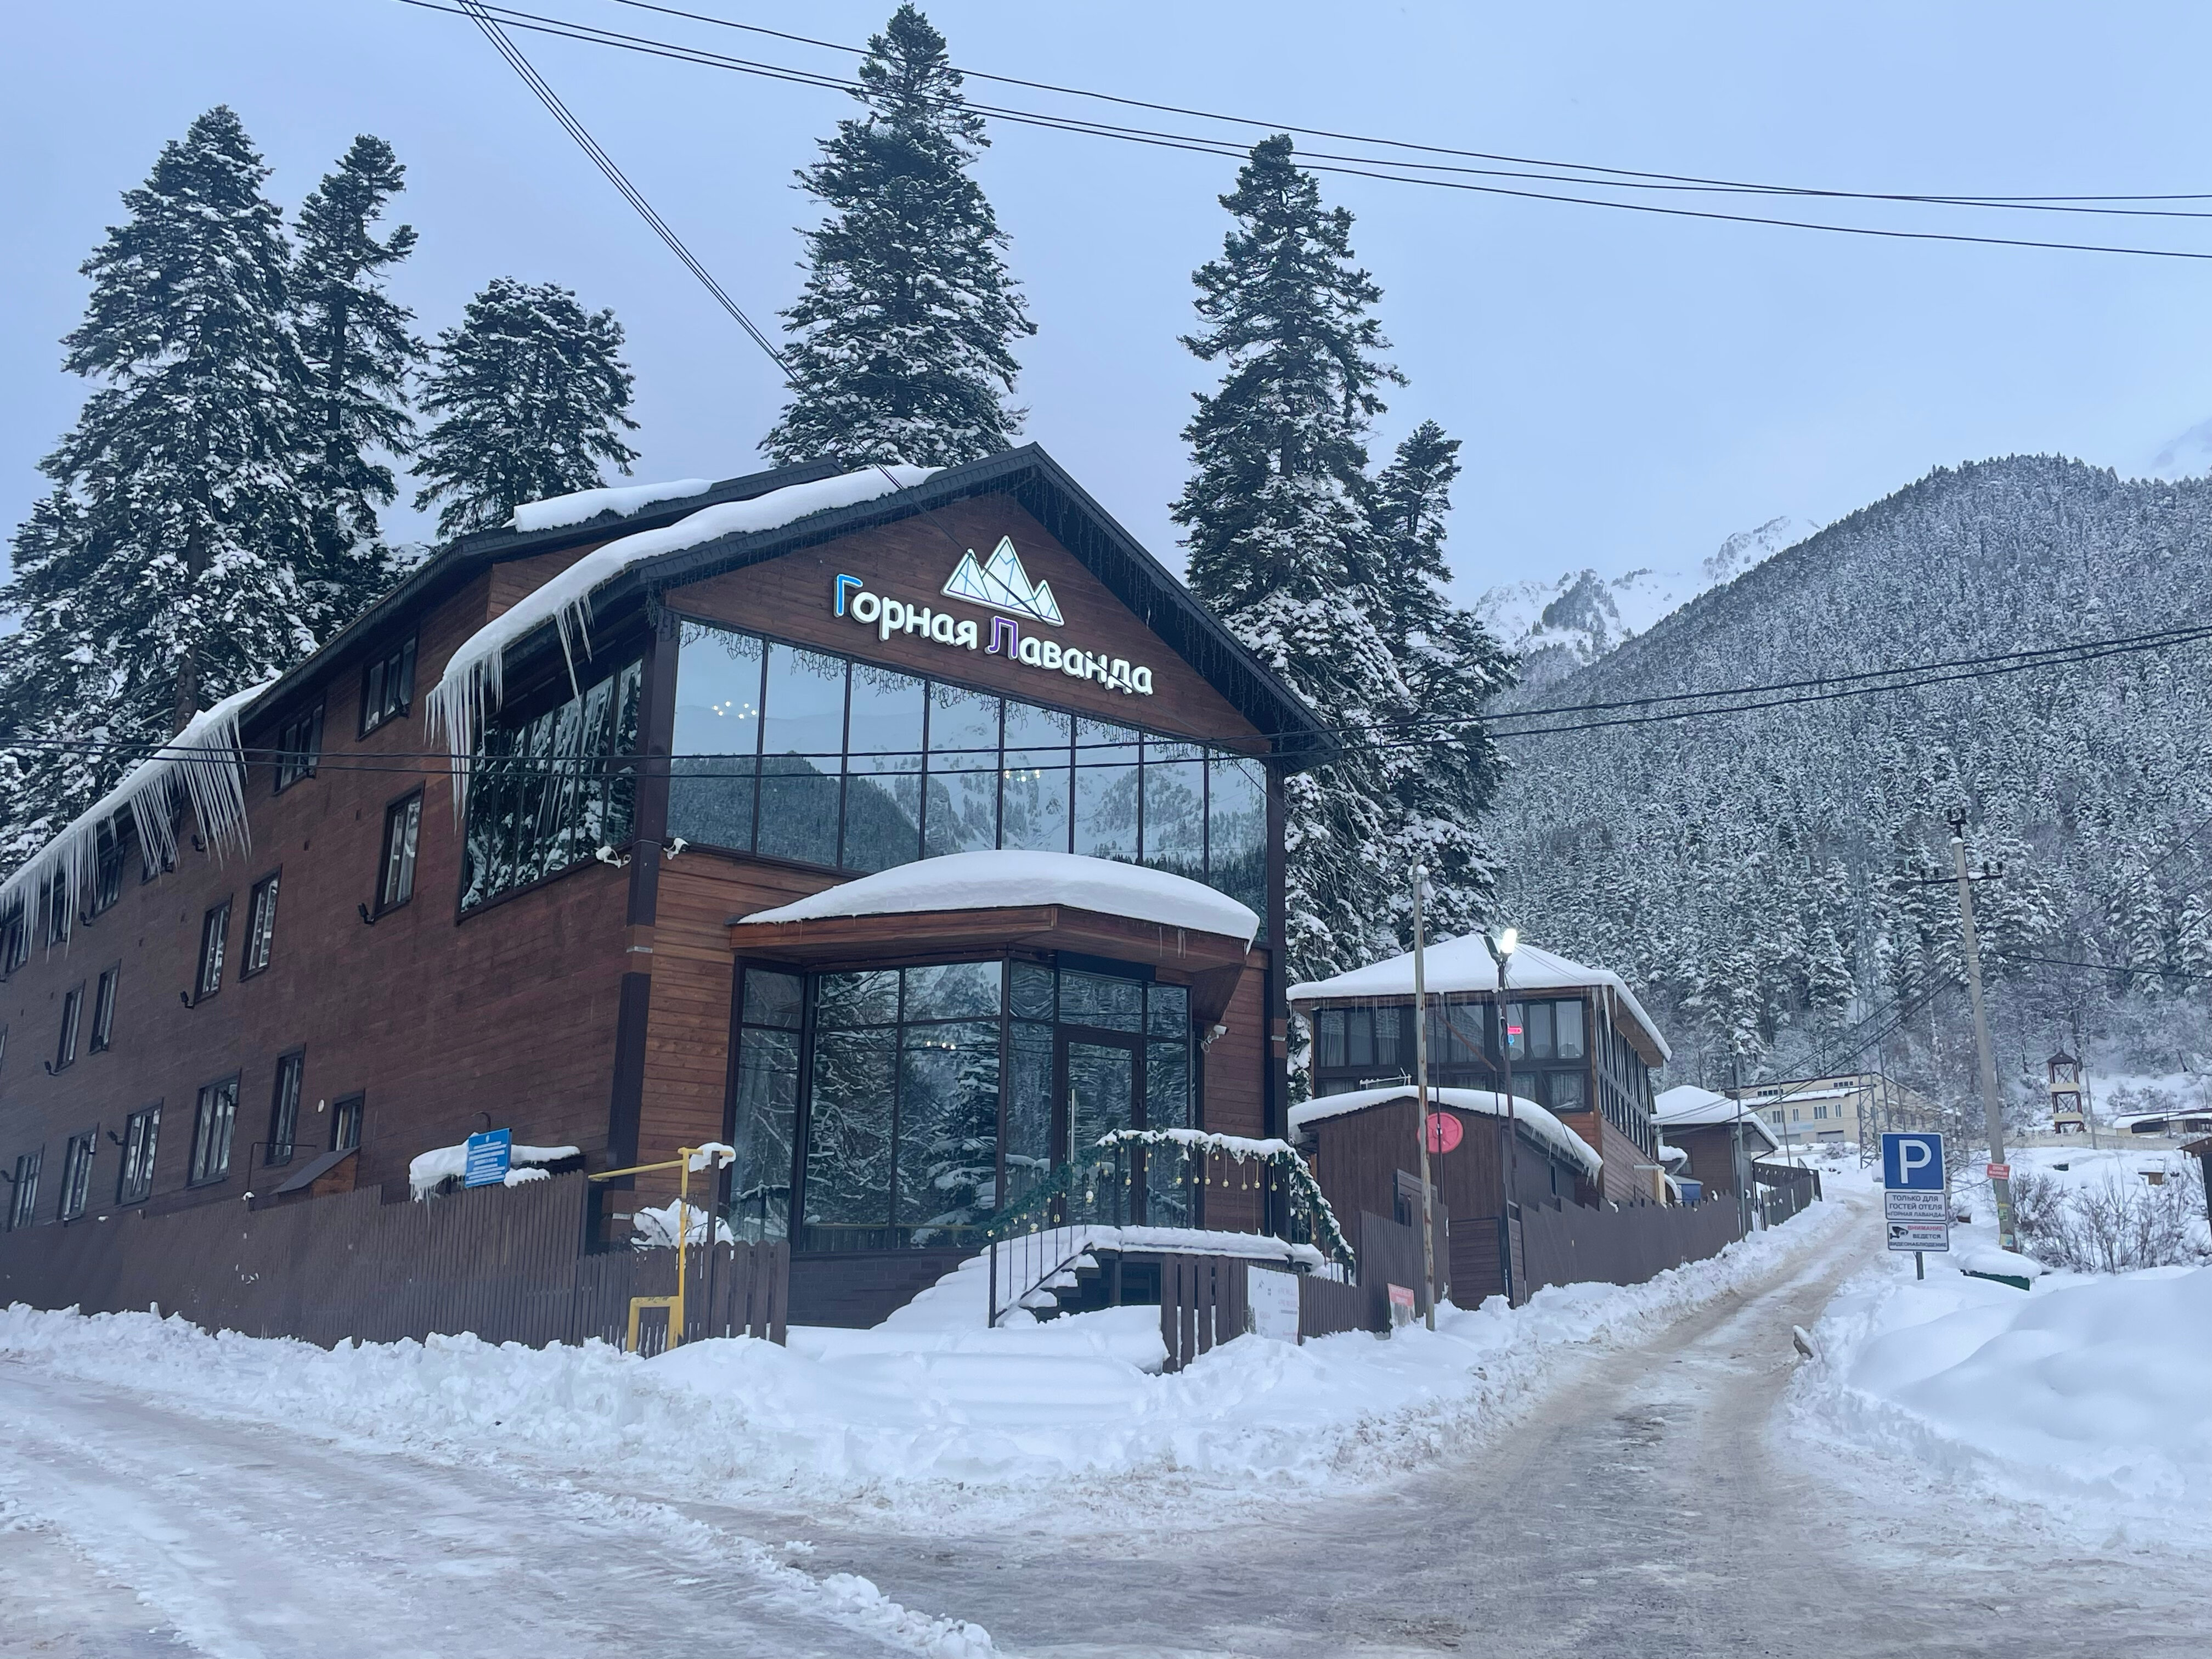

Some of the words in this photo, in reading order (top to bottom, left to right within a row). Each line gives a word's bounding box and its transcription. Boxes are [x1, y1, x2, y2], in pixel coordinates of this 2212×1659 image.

[834, 573, 977, 650] Горная
[985, 616, 1153, 695] Лаванда
[1899, 1139, 1932, 1184] P
